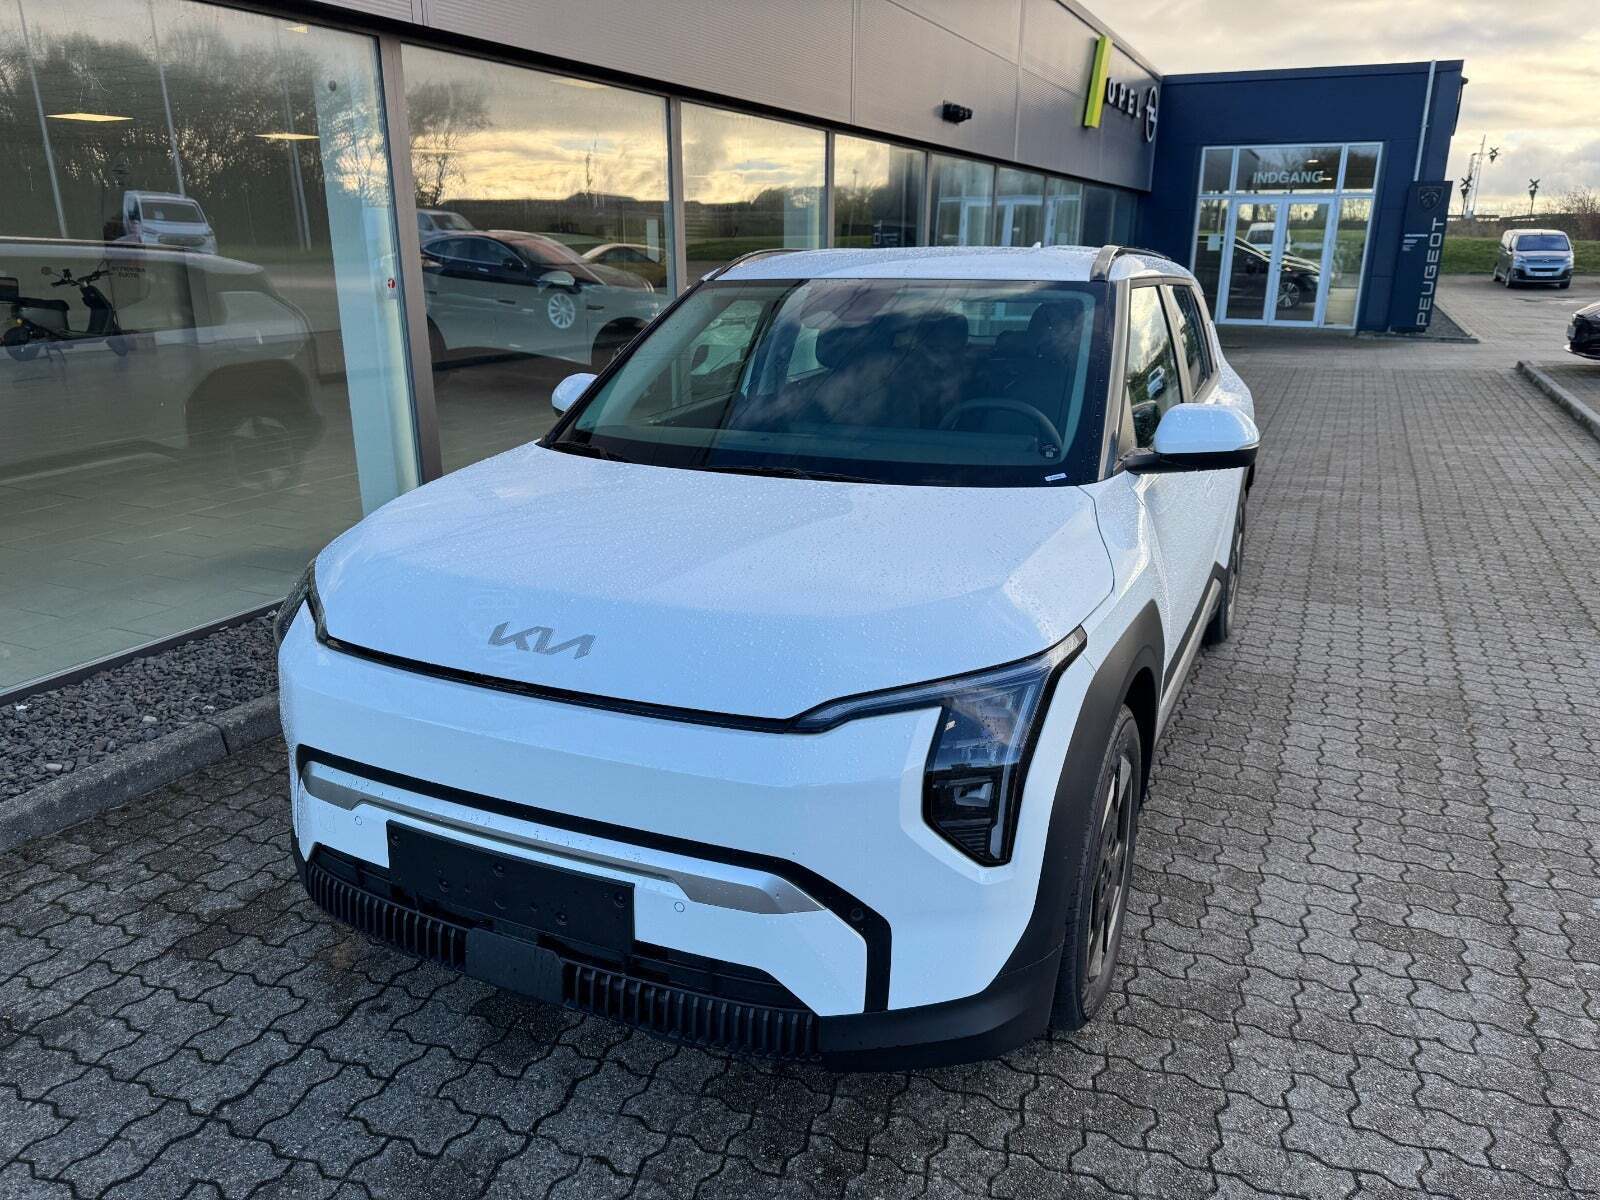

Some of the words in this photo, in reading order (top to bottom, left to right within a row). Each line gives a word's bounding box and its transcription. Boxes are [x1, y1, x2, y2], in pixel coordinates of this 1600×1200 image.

[1107, 79, 1141, 118] OPEL
[1252, 170, 1324, 184] INDGANG
[1416, 217, 1445, 326] PEUGEOT
[487, 621, 595, 660] KIA
